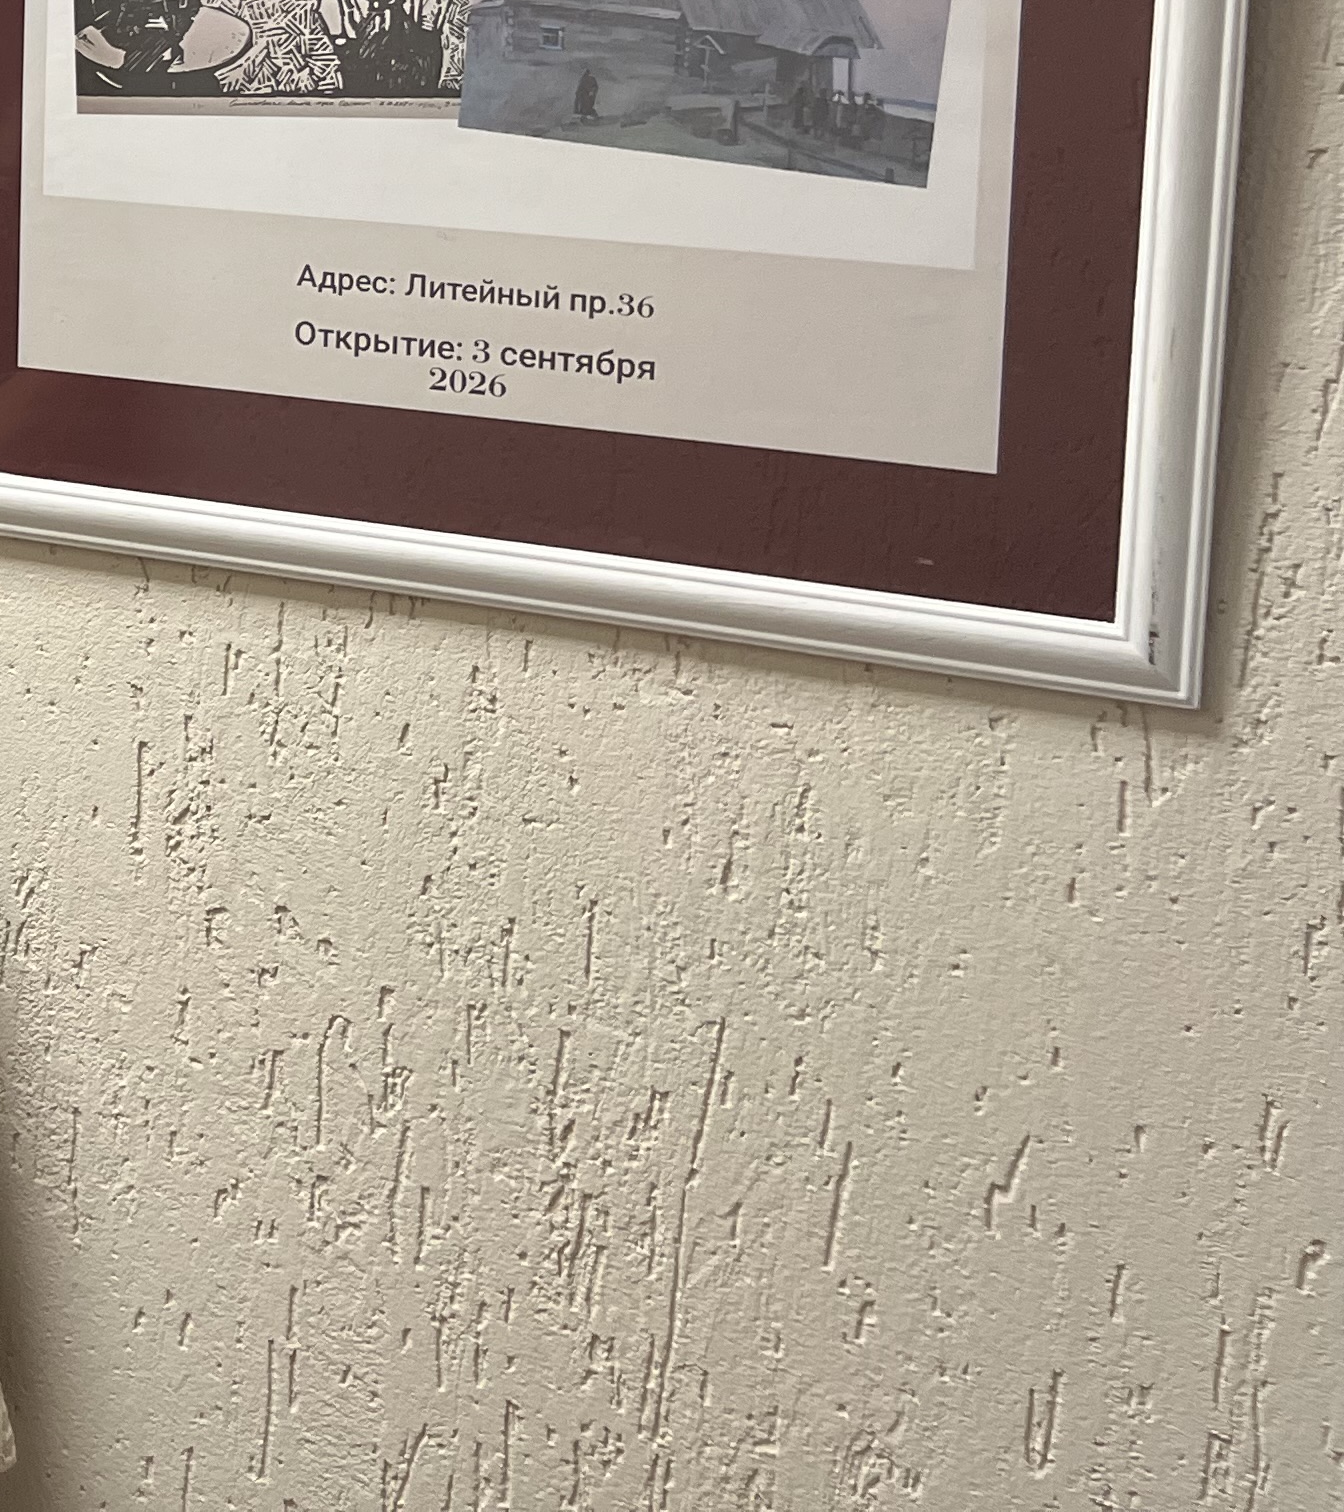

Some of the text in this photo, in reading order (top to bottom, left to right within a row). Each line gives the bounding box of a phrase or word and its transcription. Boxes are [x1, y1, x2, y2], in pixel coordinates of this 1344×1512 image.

[296, 264, 656, 319] Адрес: Литейный пр.36
[294, 321, 657, 384] Открытие: 3 сентября
[428, 366, 508, 398] 2026
